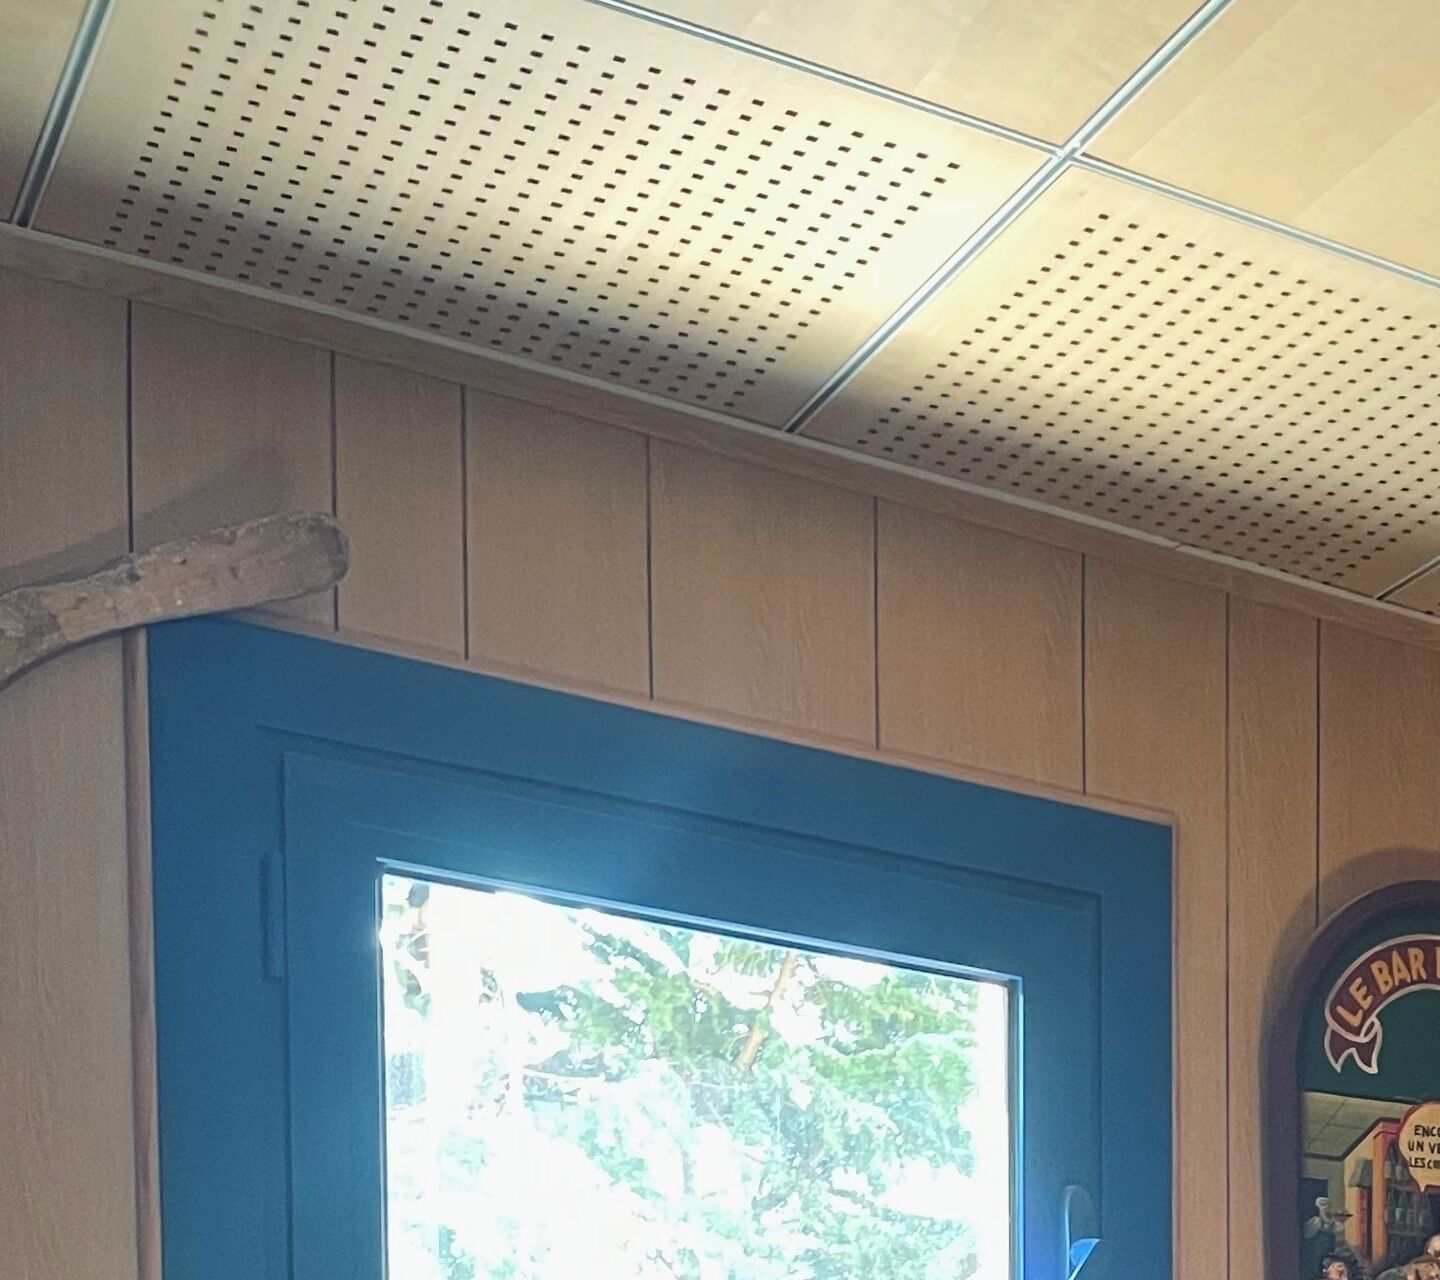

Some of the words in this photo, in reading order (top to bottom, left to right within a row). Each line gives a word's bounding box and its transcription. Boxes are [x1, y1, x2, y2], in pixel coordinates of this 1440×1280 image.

[1337, 977, 1373, 1027] LE
[1371, 947, 1427, 995] BAR
[1407, 1141, 1425, 1152] UN
[1409, 1157, 1426, 1168] LES
